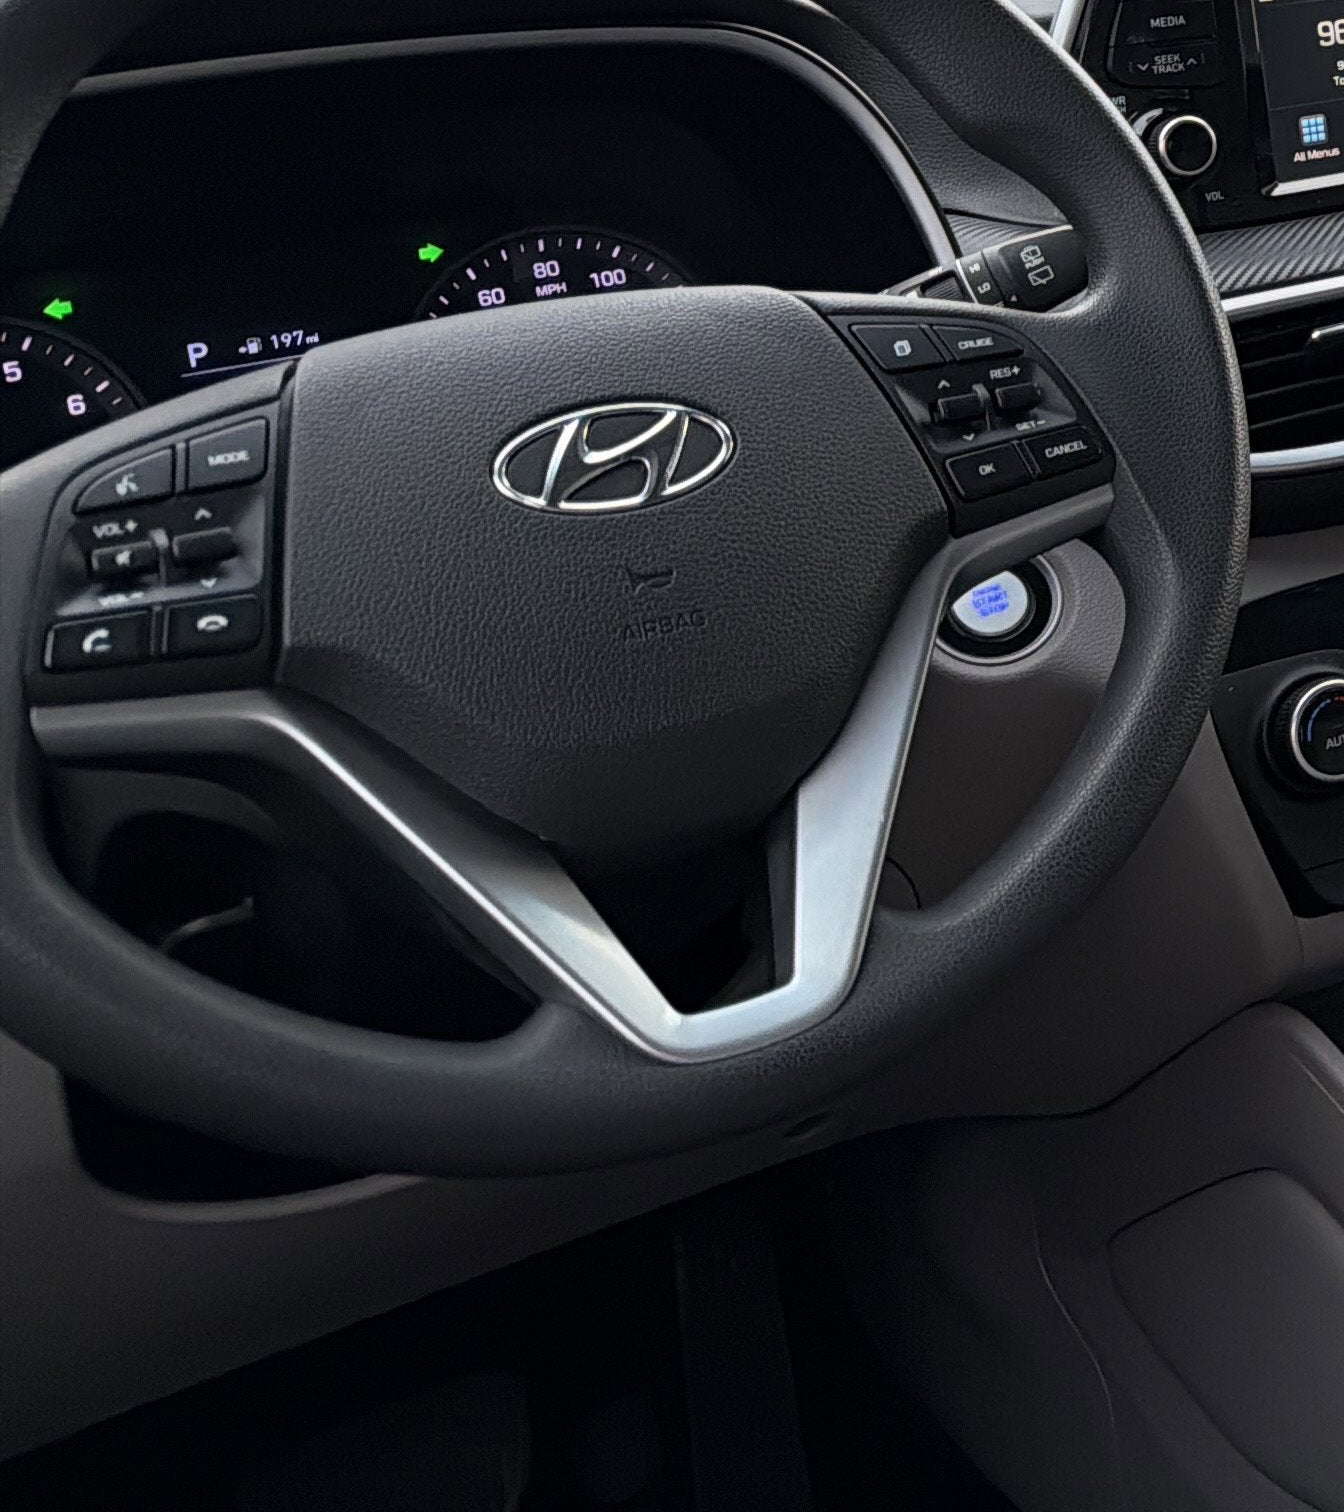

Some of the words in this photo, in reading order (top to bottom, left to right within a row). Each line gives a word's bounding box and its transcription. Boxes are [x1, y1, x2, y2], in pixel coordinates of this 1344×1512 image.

[1150, 15, 1186, 29] MEDIA
[1154, 52, 1181, 64] SEEK
[1151, 62, 1186, 75] TRACK
[1293, 151, 1307, 163] All
[1307, 147, 1341, 160] Menus
[1205, 191, 1224, 202] VOL
[532, 259, 560, 279] 80
[589, 268, 627, 289] 100
[477, 287, 506, 307] 60
[535, 281, 568, 298] MPH
[269, 329, 304, 350] 197
[305, 331, 320, 345] mi
[957, 337, 995, 350] CRUISE
[186, 341, 208, 368] P
[2, 360, 22, 383] 5
[66, 393, 86, 416] 6
[207, 450, 249, 466] MODE
[1044, 439, 1088, 459] CANCEL
[978, 462, 997, 476] OK
[623, 609, 707, 642] AIRBAG
